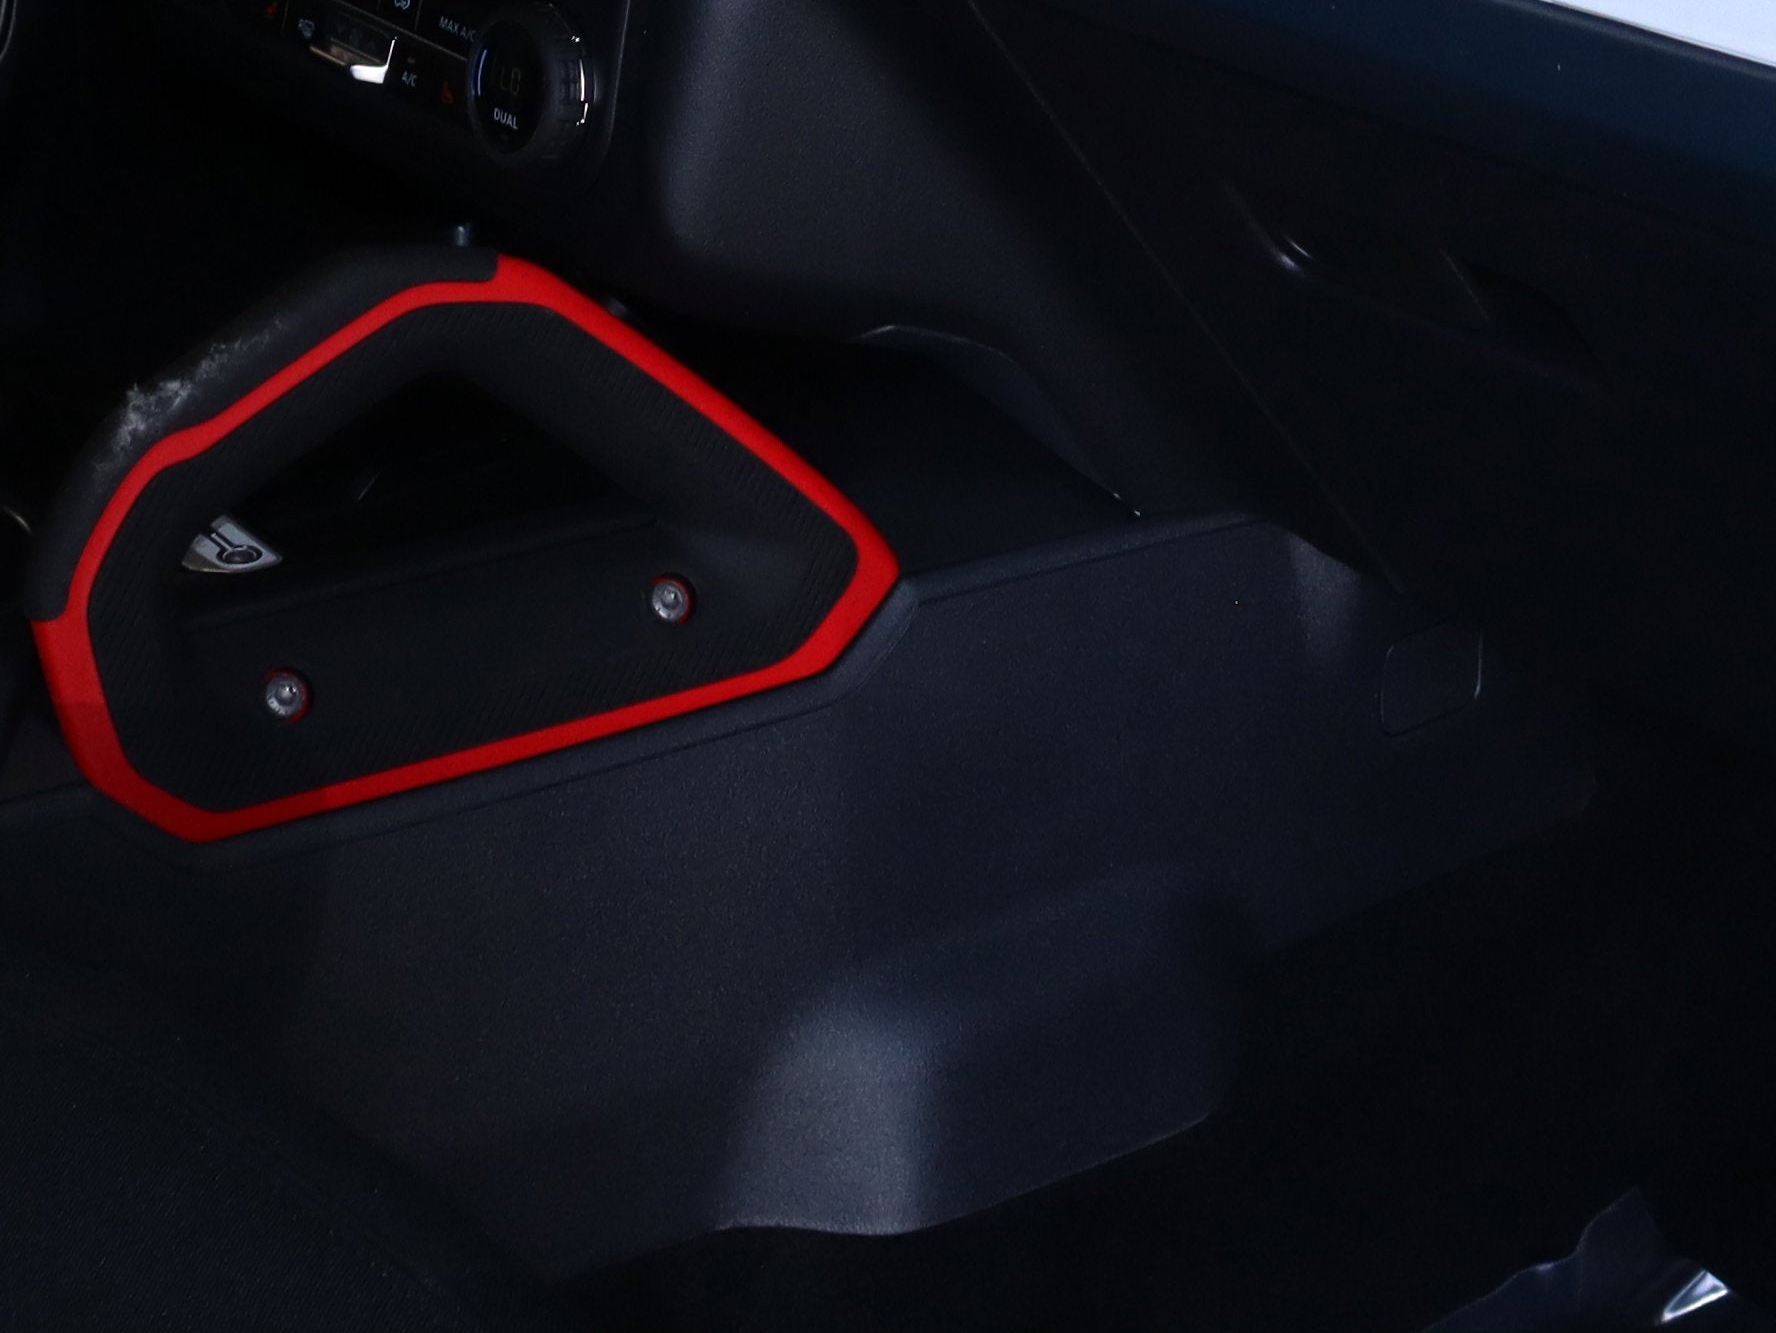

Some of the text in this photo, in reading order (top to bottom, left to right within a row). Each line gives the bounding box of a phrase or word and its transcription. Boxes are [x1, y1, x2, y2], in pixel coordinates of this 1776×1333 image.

[438, 14, 460, 35] MAX
[401, 69, 419, 89] A/C
[493, 106, 520, 131] DUAL
